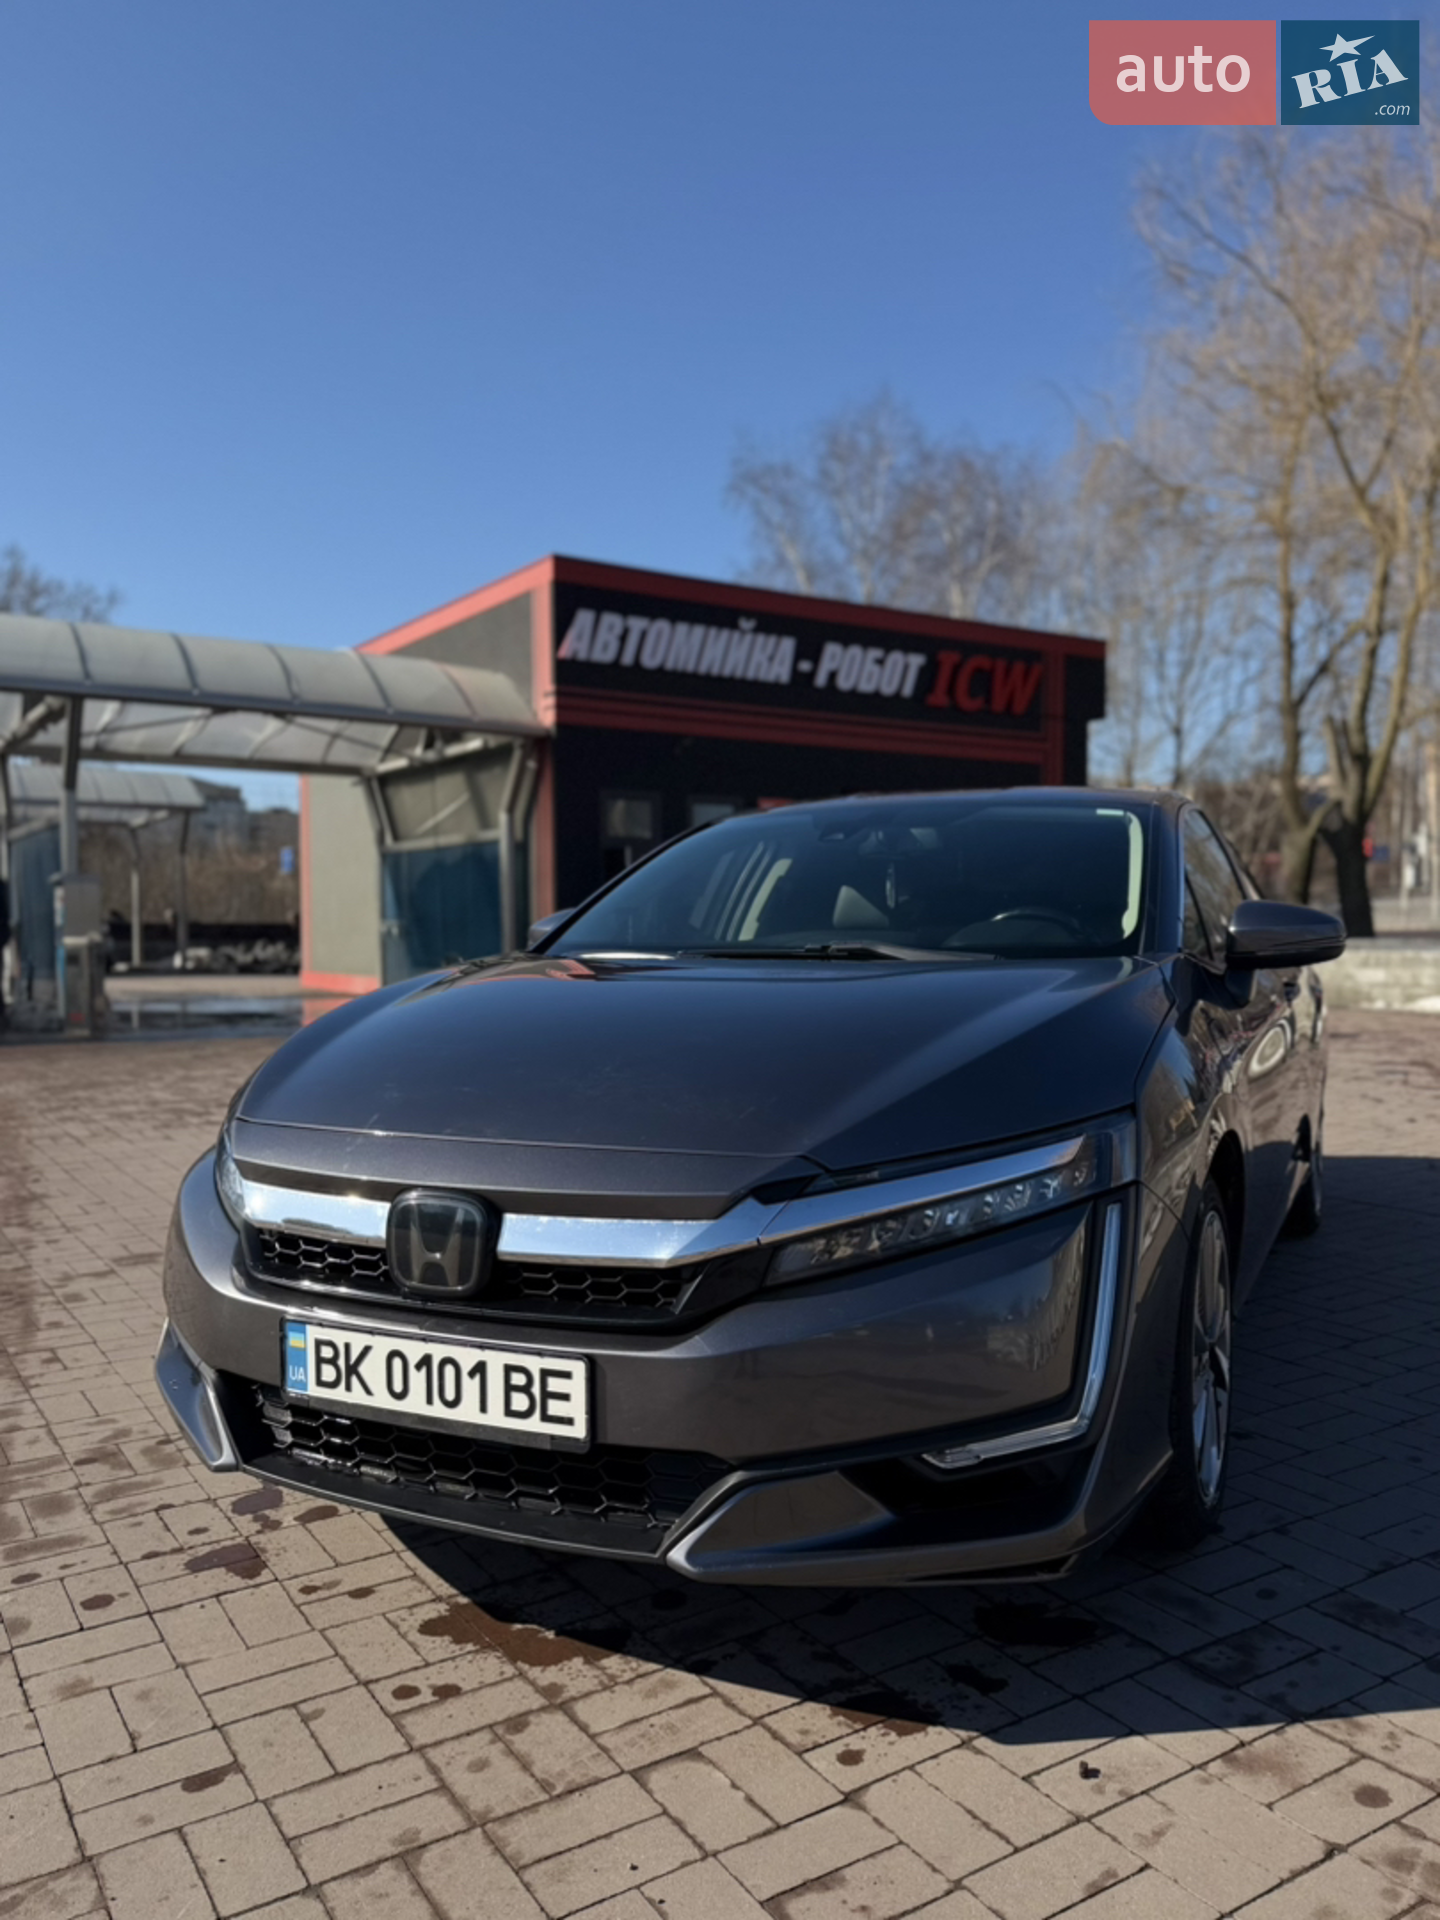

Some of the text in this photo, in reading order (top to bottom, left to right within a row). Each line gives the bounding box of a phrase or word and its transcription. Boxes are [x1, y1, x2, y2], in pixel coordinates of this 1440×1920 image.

[558, 608, 796, 685] АВТОМИЙКА
[814, 641, 926, 698] РОБОТ
[925, 650, 1043, 716] ICW
[289, 1365, 306, 1383] UA
[314, 1338, 574, 1426] BK 0101 BE
